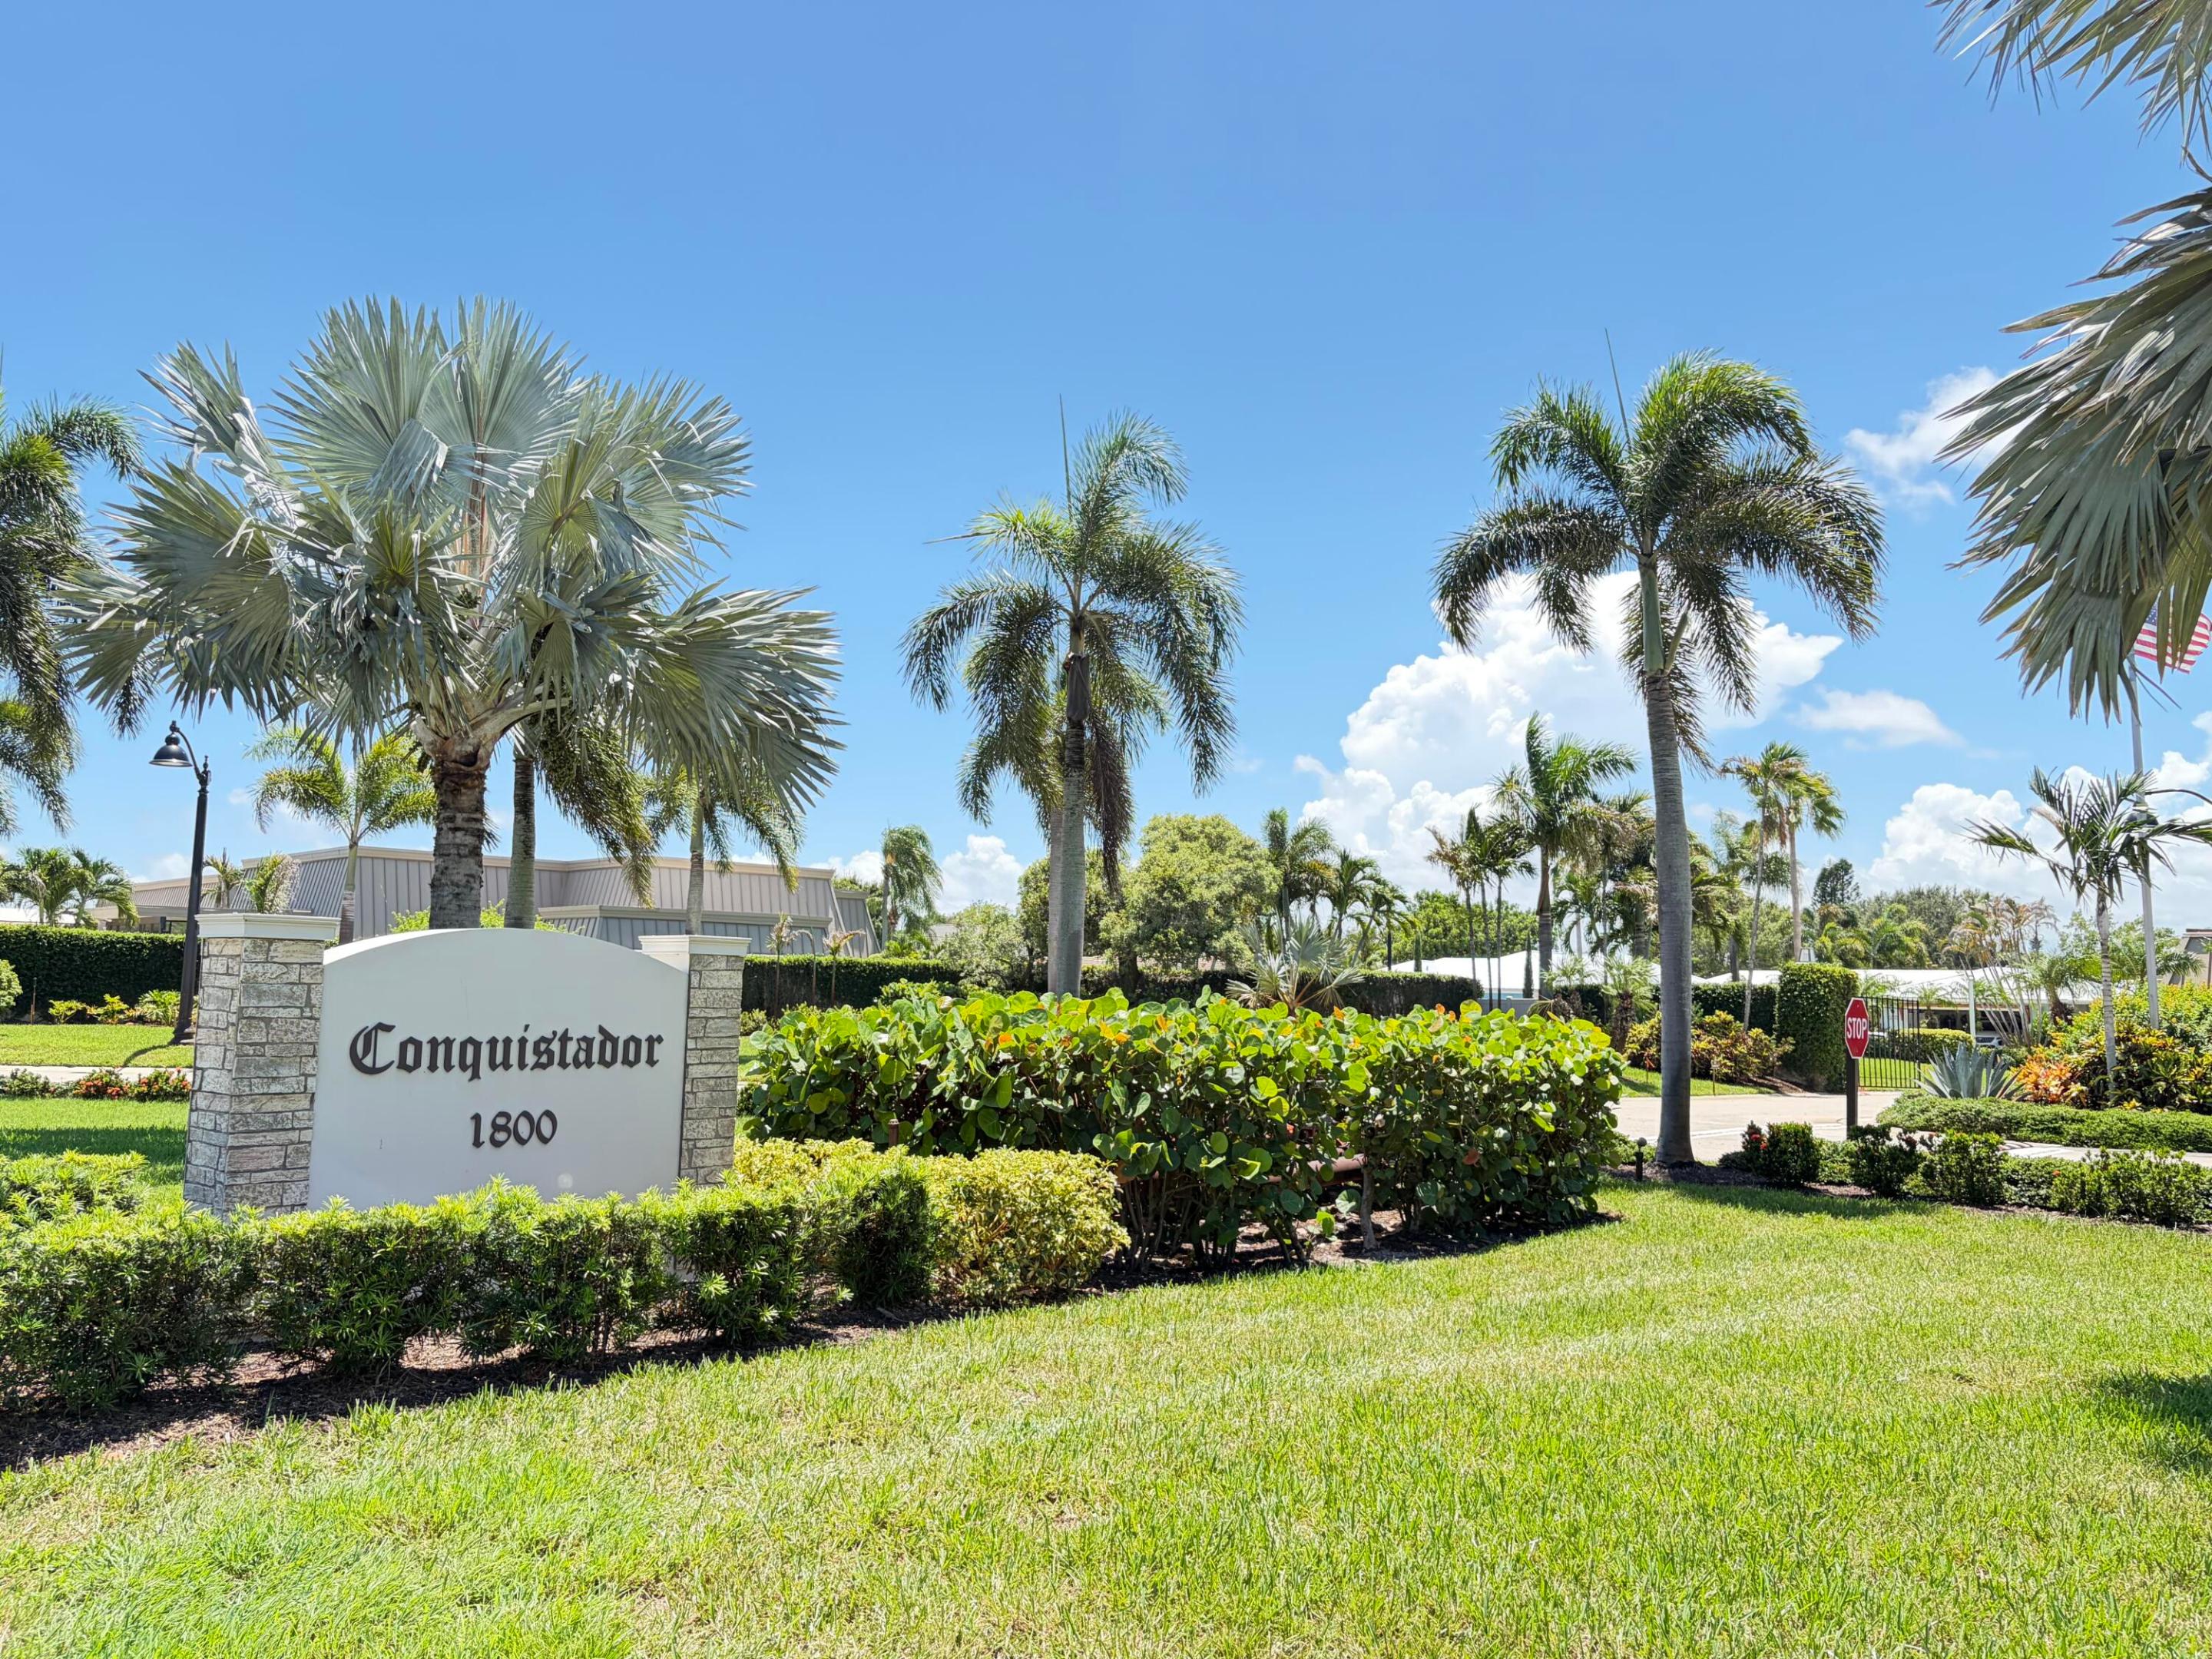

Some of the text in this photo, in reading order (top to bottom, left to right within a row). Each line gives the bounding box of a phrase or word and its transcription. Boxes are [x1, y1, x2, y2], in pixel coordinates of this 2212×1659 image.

[1847, 1017, 1867, 1039] STOP
[349, 1022, 664, 1081] Conquistador
[470, 1110, 558, 1149] 1800
